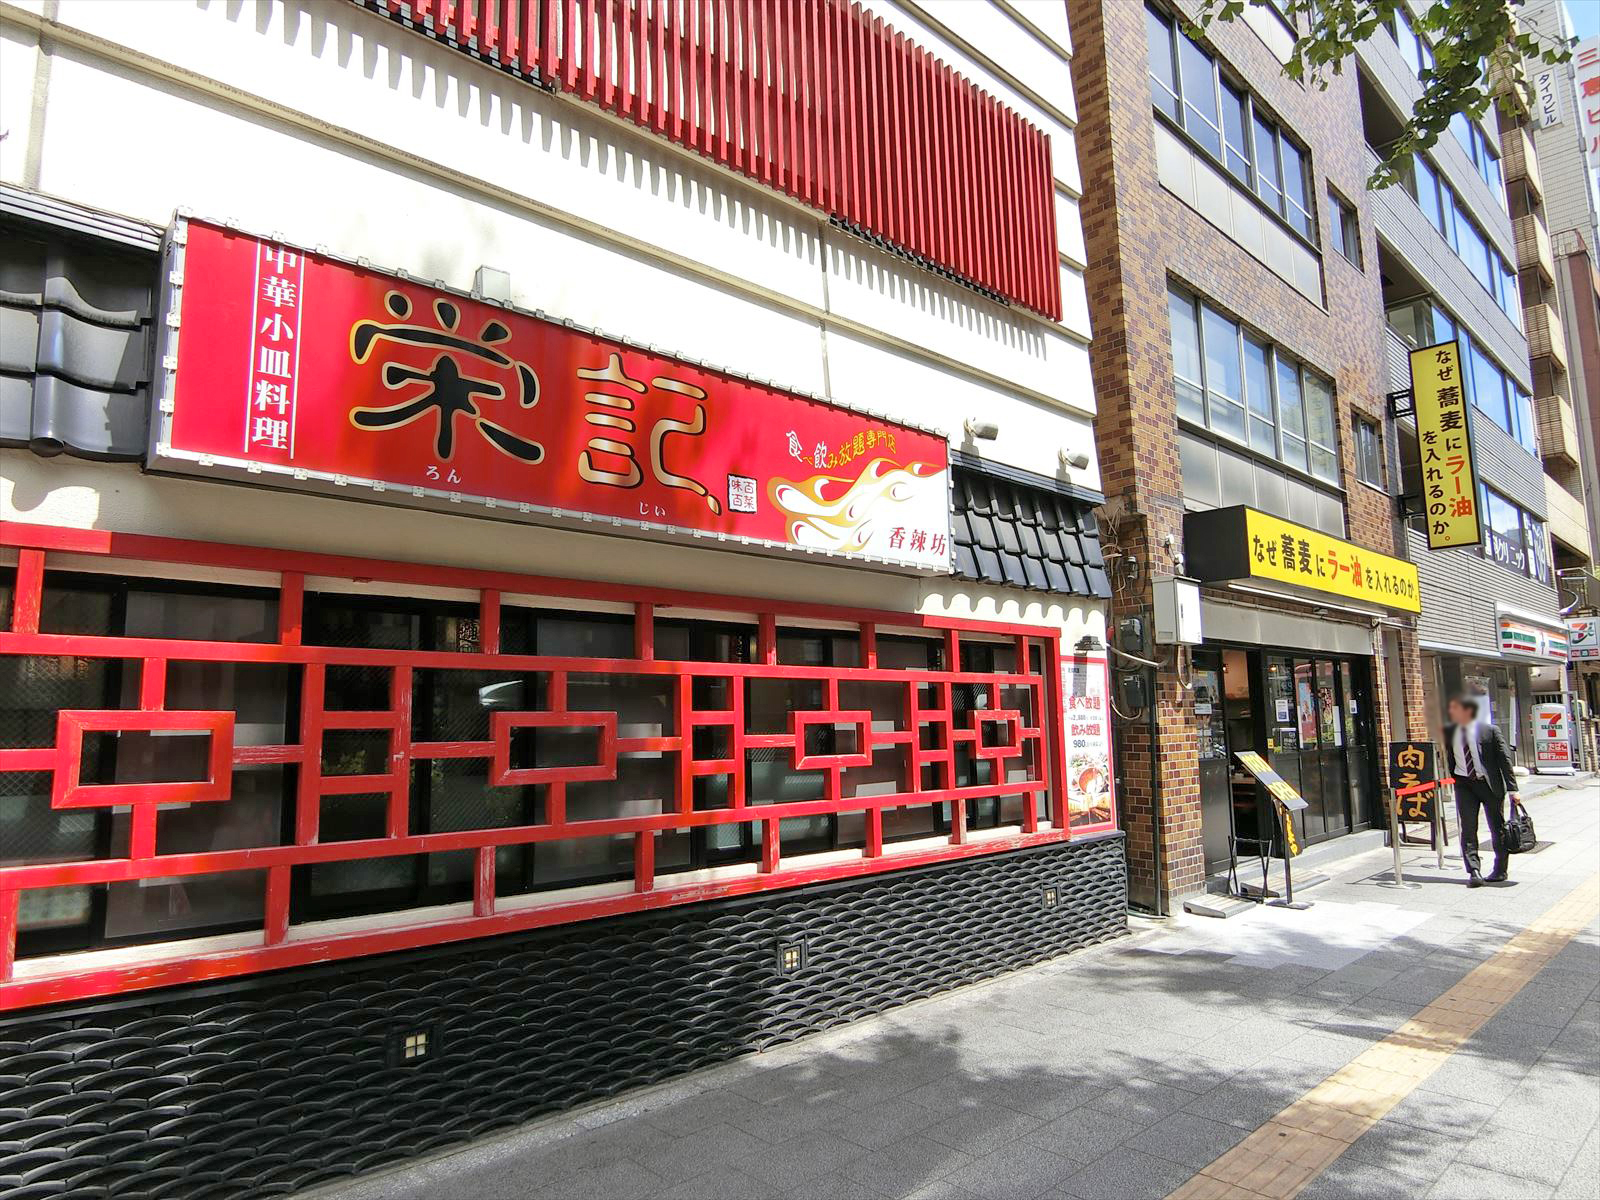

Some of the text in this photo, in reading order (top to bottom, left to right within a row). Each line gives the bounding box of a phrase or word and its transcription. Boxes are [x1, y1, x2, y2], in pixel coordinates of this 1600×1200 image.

[251, 244, 297, 451] 中華小皿料理
[1435, 350, 1473, 518] なぜ蕎麦にラー油
[425, 464, 463, 485] ろん
[638, 501, 667, 518] じい
[1422, 430, 1451, 542] を入れるのか。
[888, 526, 948, 556] 香辣坊
